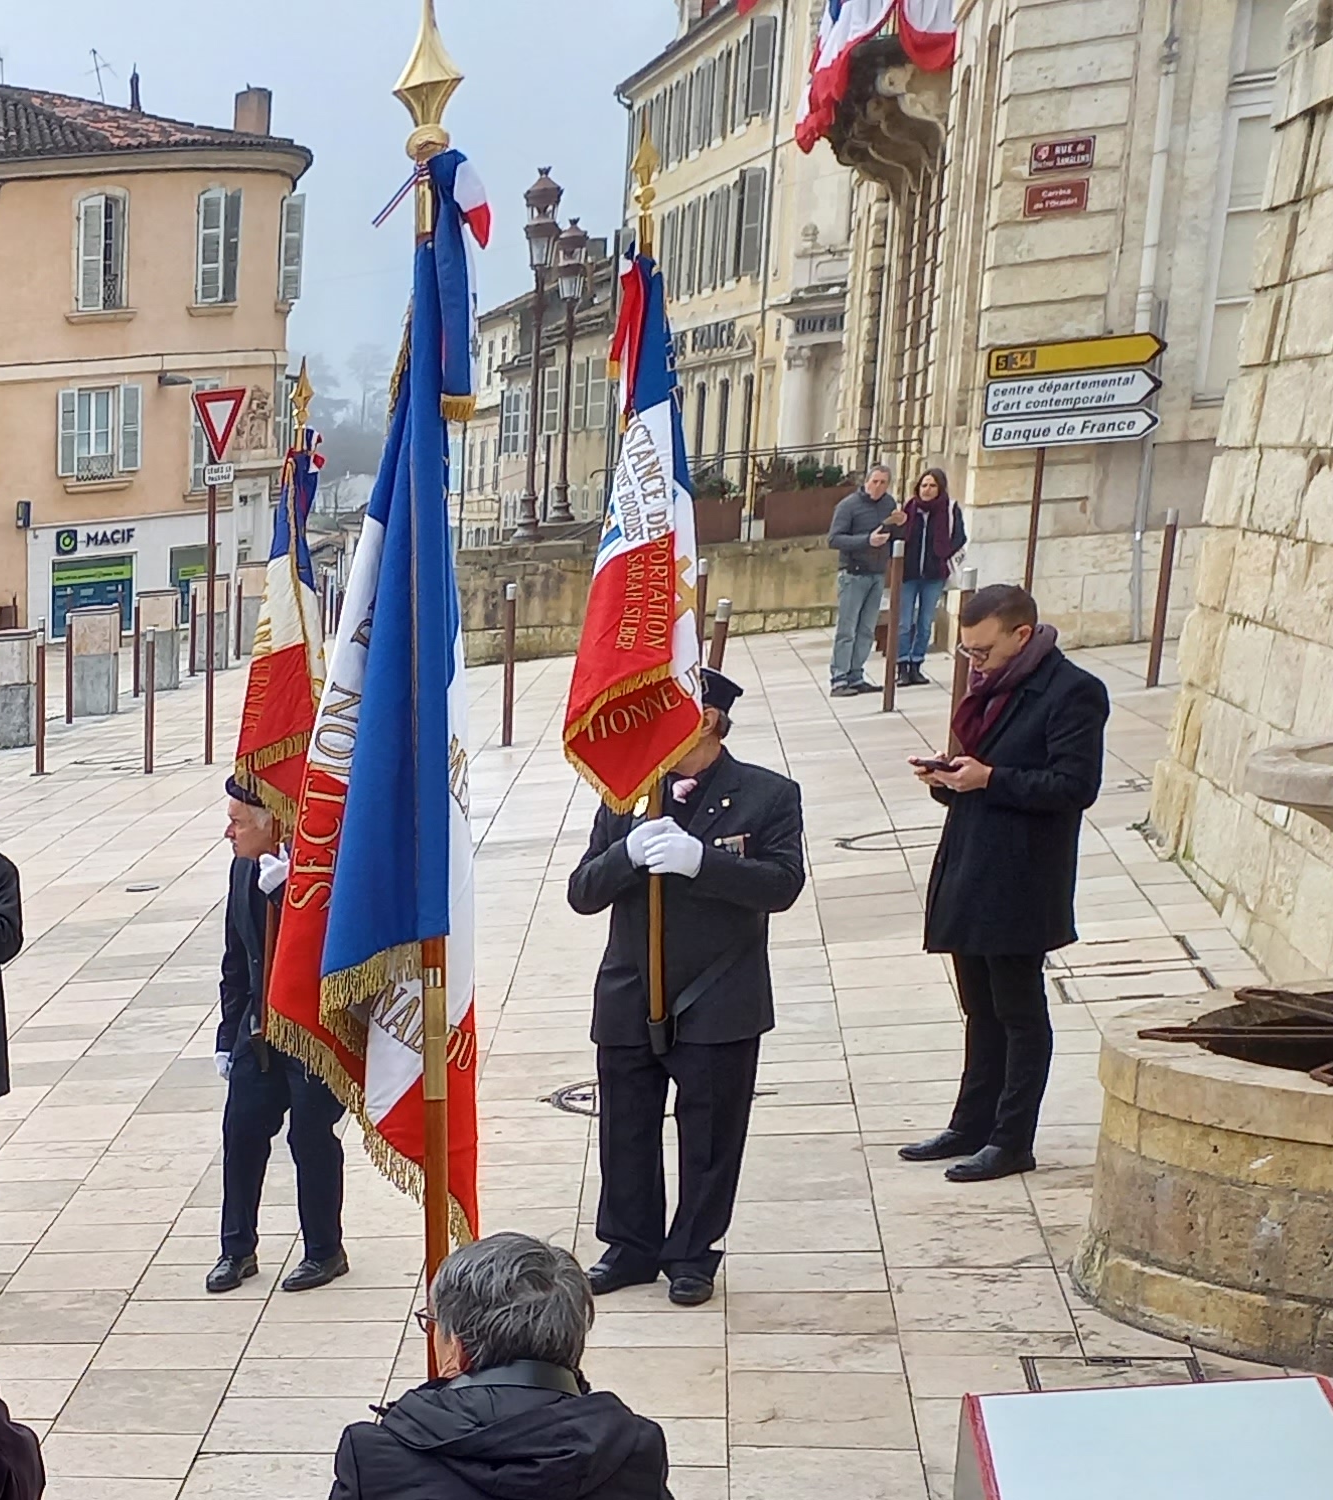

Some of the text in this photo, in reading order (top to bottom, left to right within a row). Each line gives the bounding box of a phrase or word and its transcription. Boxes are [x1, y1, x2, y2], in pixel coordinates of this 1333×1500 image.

[1054, 143, 1073, 155] RUE
[1011, 351, 1033, 369] 34
[992, 374, 1135, 397] centre départemental
[991, 391, 1115, 412] d'art contemporain
[991, 419, 1136, 442] Banque de France
[618, 488, 645, 543] BORDES
[85, 527, 136, 547] MACIF
[614, 553, 646, 651] SARAH SILBER
